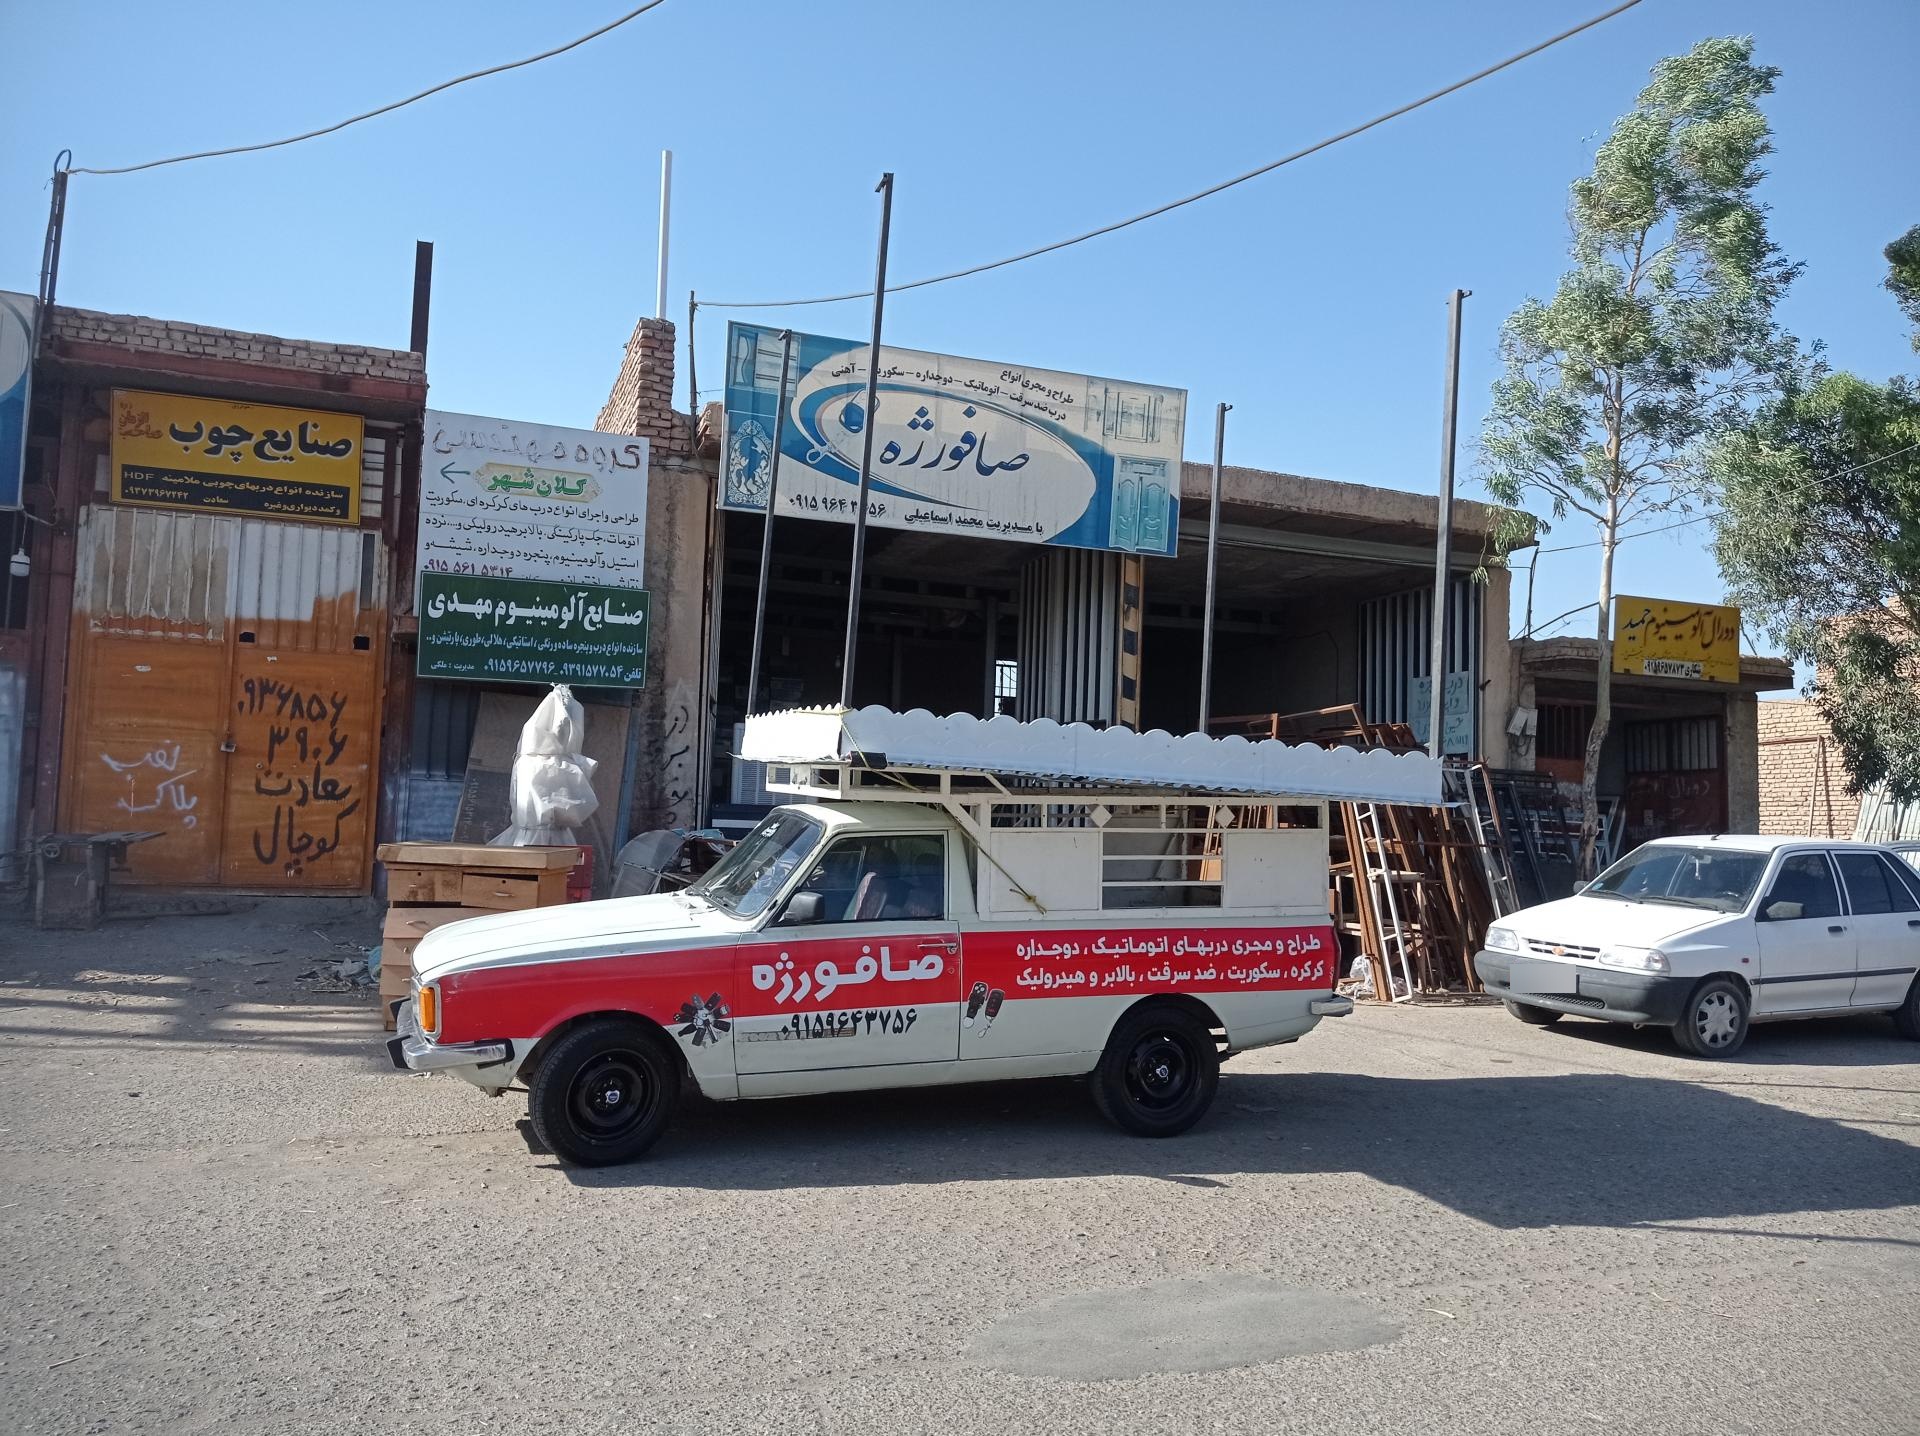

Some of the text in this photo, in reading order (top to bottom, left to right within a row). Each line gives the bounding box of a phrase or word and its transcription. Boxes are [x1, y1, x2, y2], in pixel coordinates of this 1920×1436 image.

[831, 362, 856, 377] آهنی
[916, 369, 953, 385] دوجداره
[964, 380, 1000, 396] اتوماتیک
[1000, 369, 1074, 404] طراح و مجری انواع
[1009, 392, 1034, 408] سرقت
[1034, 401, 1049, 412] ضد
[1049, 407, 1066, 421] درب
[168, 419, 353, 463] صنایع چوب
[878, 405, 1031, 477] صافورژه
[124, 471, 154, 481] HDF
[161, 474, 201, 485] ملامینه
[487, 467, 587, 496] کلان شهر
[202, 480, 234, 489] چوبی
[273, 485, 302, 495] انواع
[202, 495, 229, 504] سعادت
[305, 489, 344, 499] سازنده
[425, 490, 463, 506] سکوریت
[479, 494, 510, 512] کرکره
[508, 499, 529, 511] های
[529, 505, 553, 516] درب
[553, 505, 578, 517] انواع
[578, 507, 603, 521] اجرای
[602, 514, 609, 522] و
[425, 514, 447, 528] نرده
[610, 512, 639, 526] طراحی
[904, 508, 1044, 535] با مدیریت محمد اسماعیلی
[462, 516, 518, 538] هیدرولیکی
[516, 523, 542, 541] بالابر
[584, 528, 603, 546] جک
[424, 542, 430, 550] و
[430, 536, 473, 556] شیشه
[523, 548, 549, 566] پنجره
[606, 557, 639, 571] استیل
[600, 561, 606, 569] و
[427, 591, 644, 631] صنایع آلومینیوم مهدی
[436, 631, 460, 647] پارتیشن
[557, 639, 574, 650] ساده
[573, 640, 589, 655] پنجره
[593, 643, 606, 654] درب
[606, 641, 623, 656] انواع
[622, 642, 642, 656] سازنده
[430, 660, 448, 670] ملکی
[453, 662, 475, 672] مدیریت
[483, 658, 555, 675] ۰۹۱۵۹۶۵۷۷۹۶
[560, 662, 624, 678] ۰۹۳۹۱۵۷۷۰۵۴
[623, 667, 642, 682] تلفن
[1016, 938, 1080, 961] دوجداره
[1172, 938, 1229, 957] دربهای
[1231, 939, 1272, 956] مجری
[1275, 940, 1283, 955] و
[1287, 934, 1321, 955] طراح
[751, 945, 944, 1005] صافورژه
[1101, 965, 1137, 988] بالابر
[1193, 962, 1217, 980] ضد
[1015, 967, 1086, 991] هیدرولیک
[1089, 972, 1099, 987] و
[781, 1007, 918, 1040] ۰۹۱۵۹۶۴۳۷۵۶
